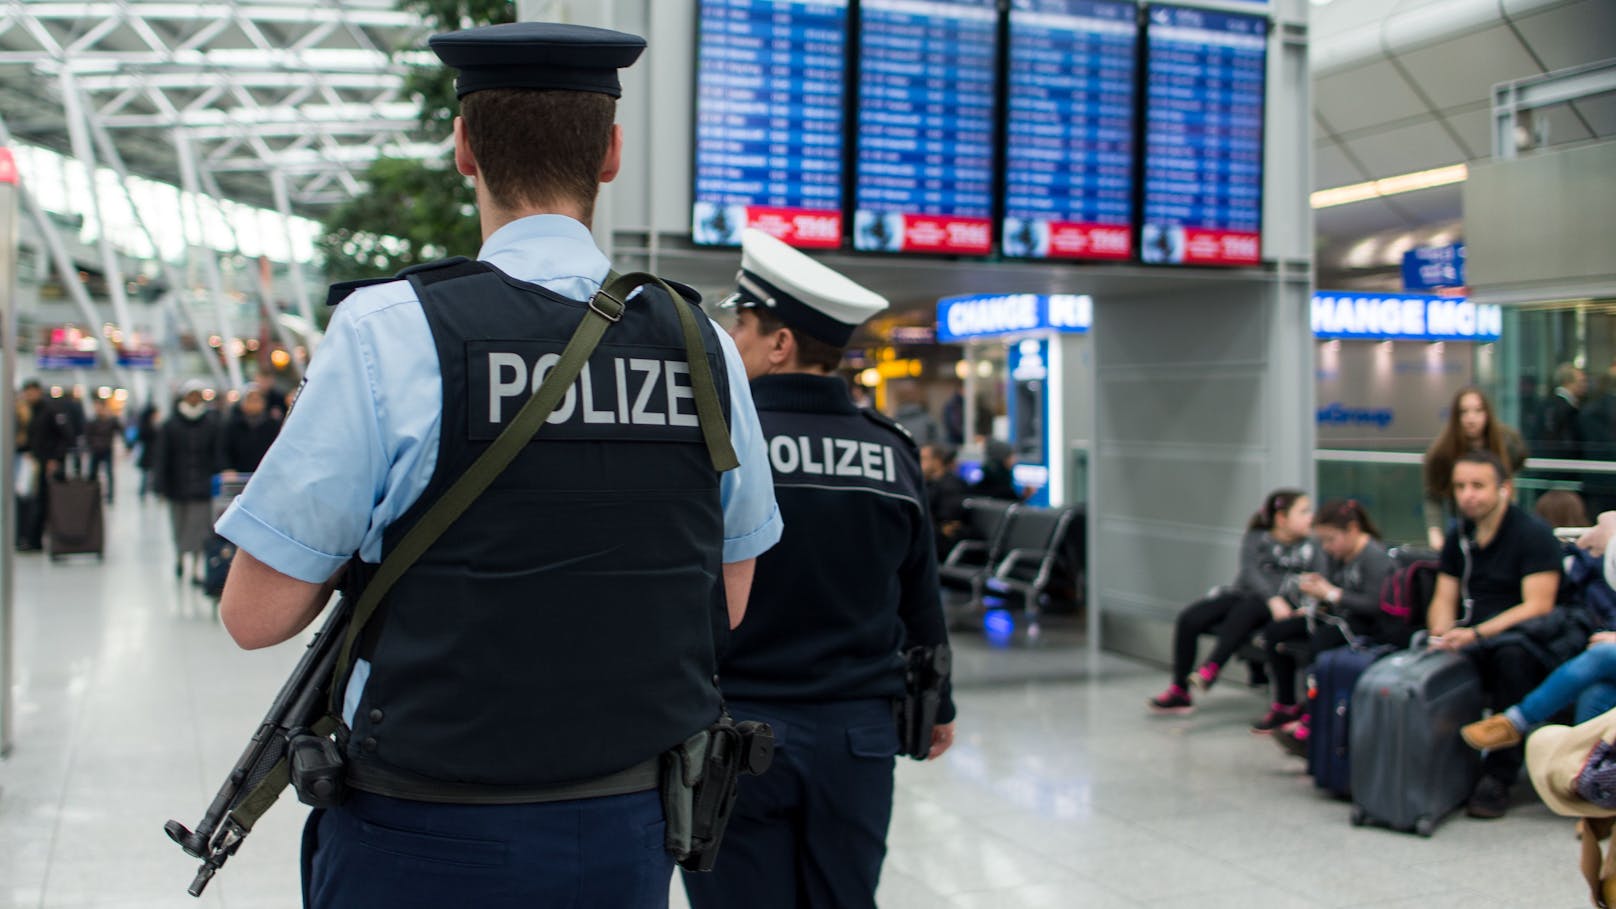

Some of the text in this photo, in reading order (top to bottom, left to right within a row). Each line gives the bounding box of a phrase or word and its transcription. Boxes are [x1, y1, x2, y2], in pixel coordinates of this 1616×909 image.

[1311, 297, 1502, 336] HANGE MON
[489, 352, 699, 427] POLIZE
[770, 435, 896, 483] OLIZEI
